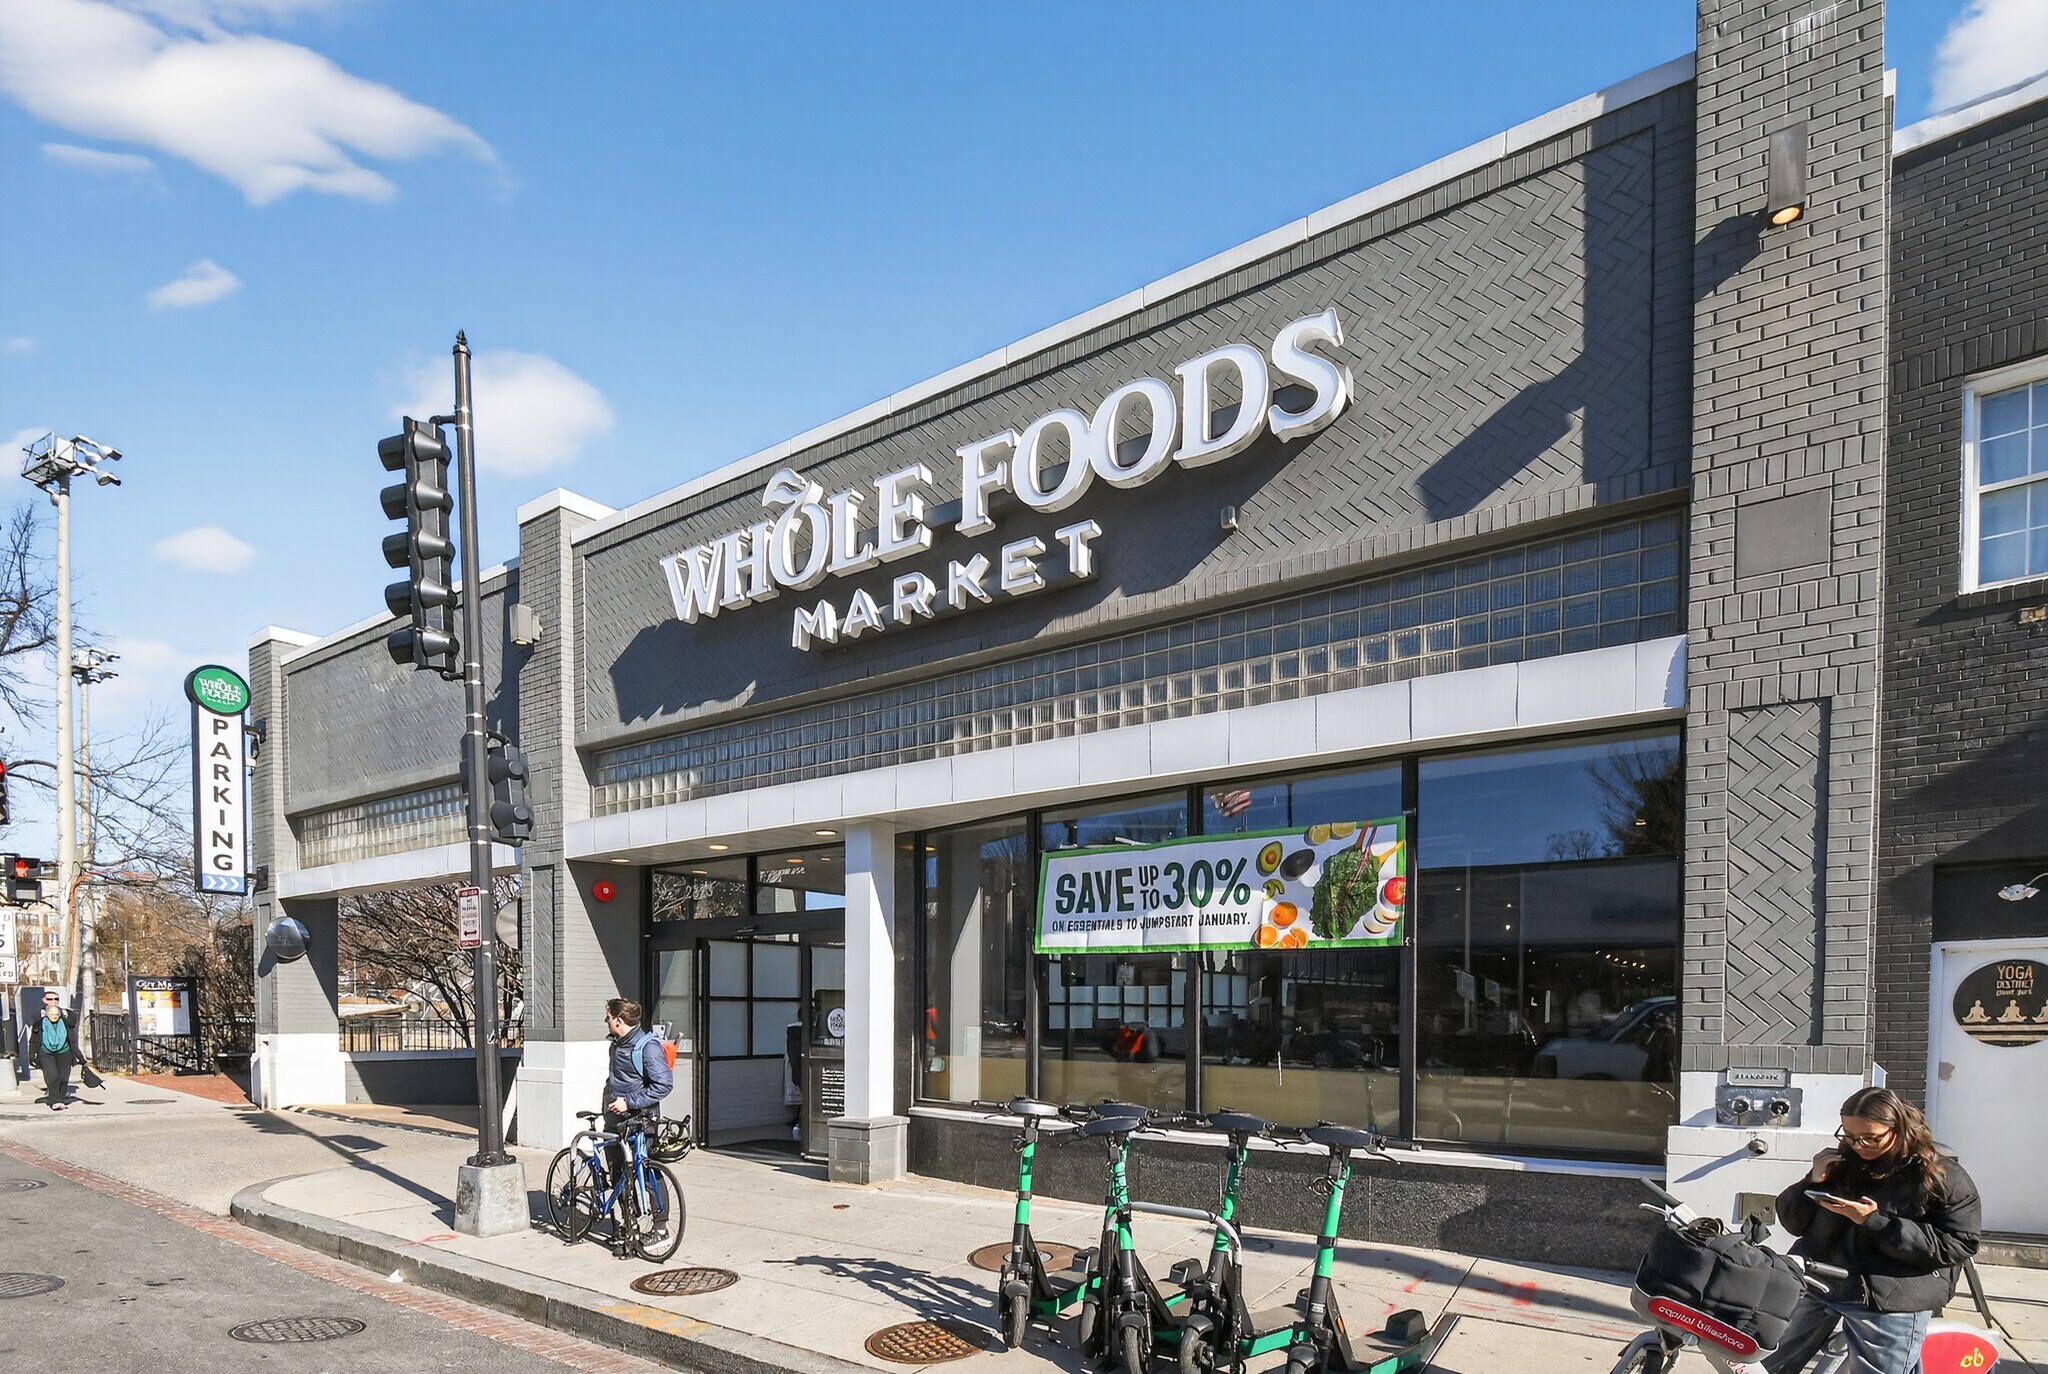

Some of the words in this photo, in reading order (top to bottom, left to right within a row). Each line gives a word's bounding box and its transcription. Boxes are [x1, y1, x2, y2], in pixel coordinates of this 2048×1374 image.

[659, 467, 932, 623] WHOLE
[955, 307, 1351, 537] FOODS
[792, 518, 1103, 652] MARKET
[210, 718, 234, 871] PARKING
[1055, 867, 1135, 915] SAVE
[1138, 864, 1160, 887] UP
[1140, 888, 1160, 910] TO
[1162, 857, 1251, 910] 30%
[1052, 920, 1065, 932] ON
[1126, 917, 1137, 930] TO
[1139, 915, 1193, 929] JUMPSTART
[1198, 912, 1250, 926] JANUARY.
[1997, 965, 2033, 980] YOGA
